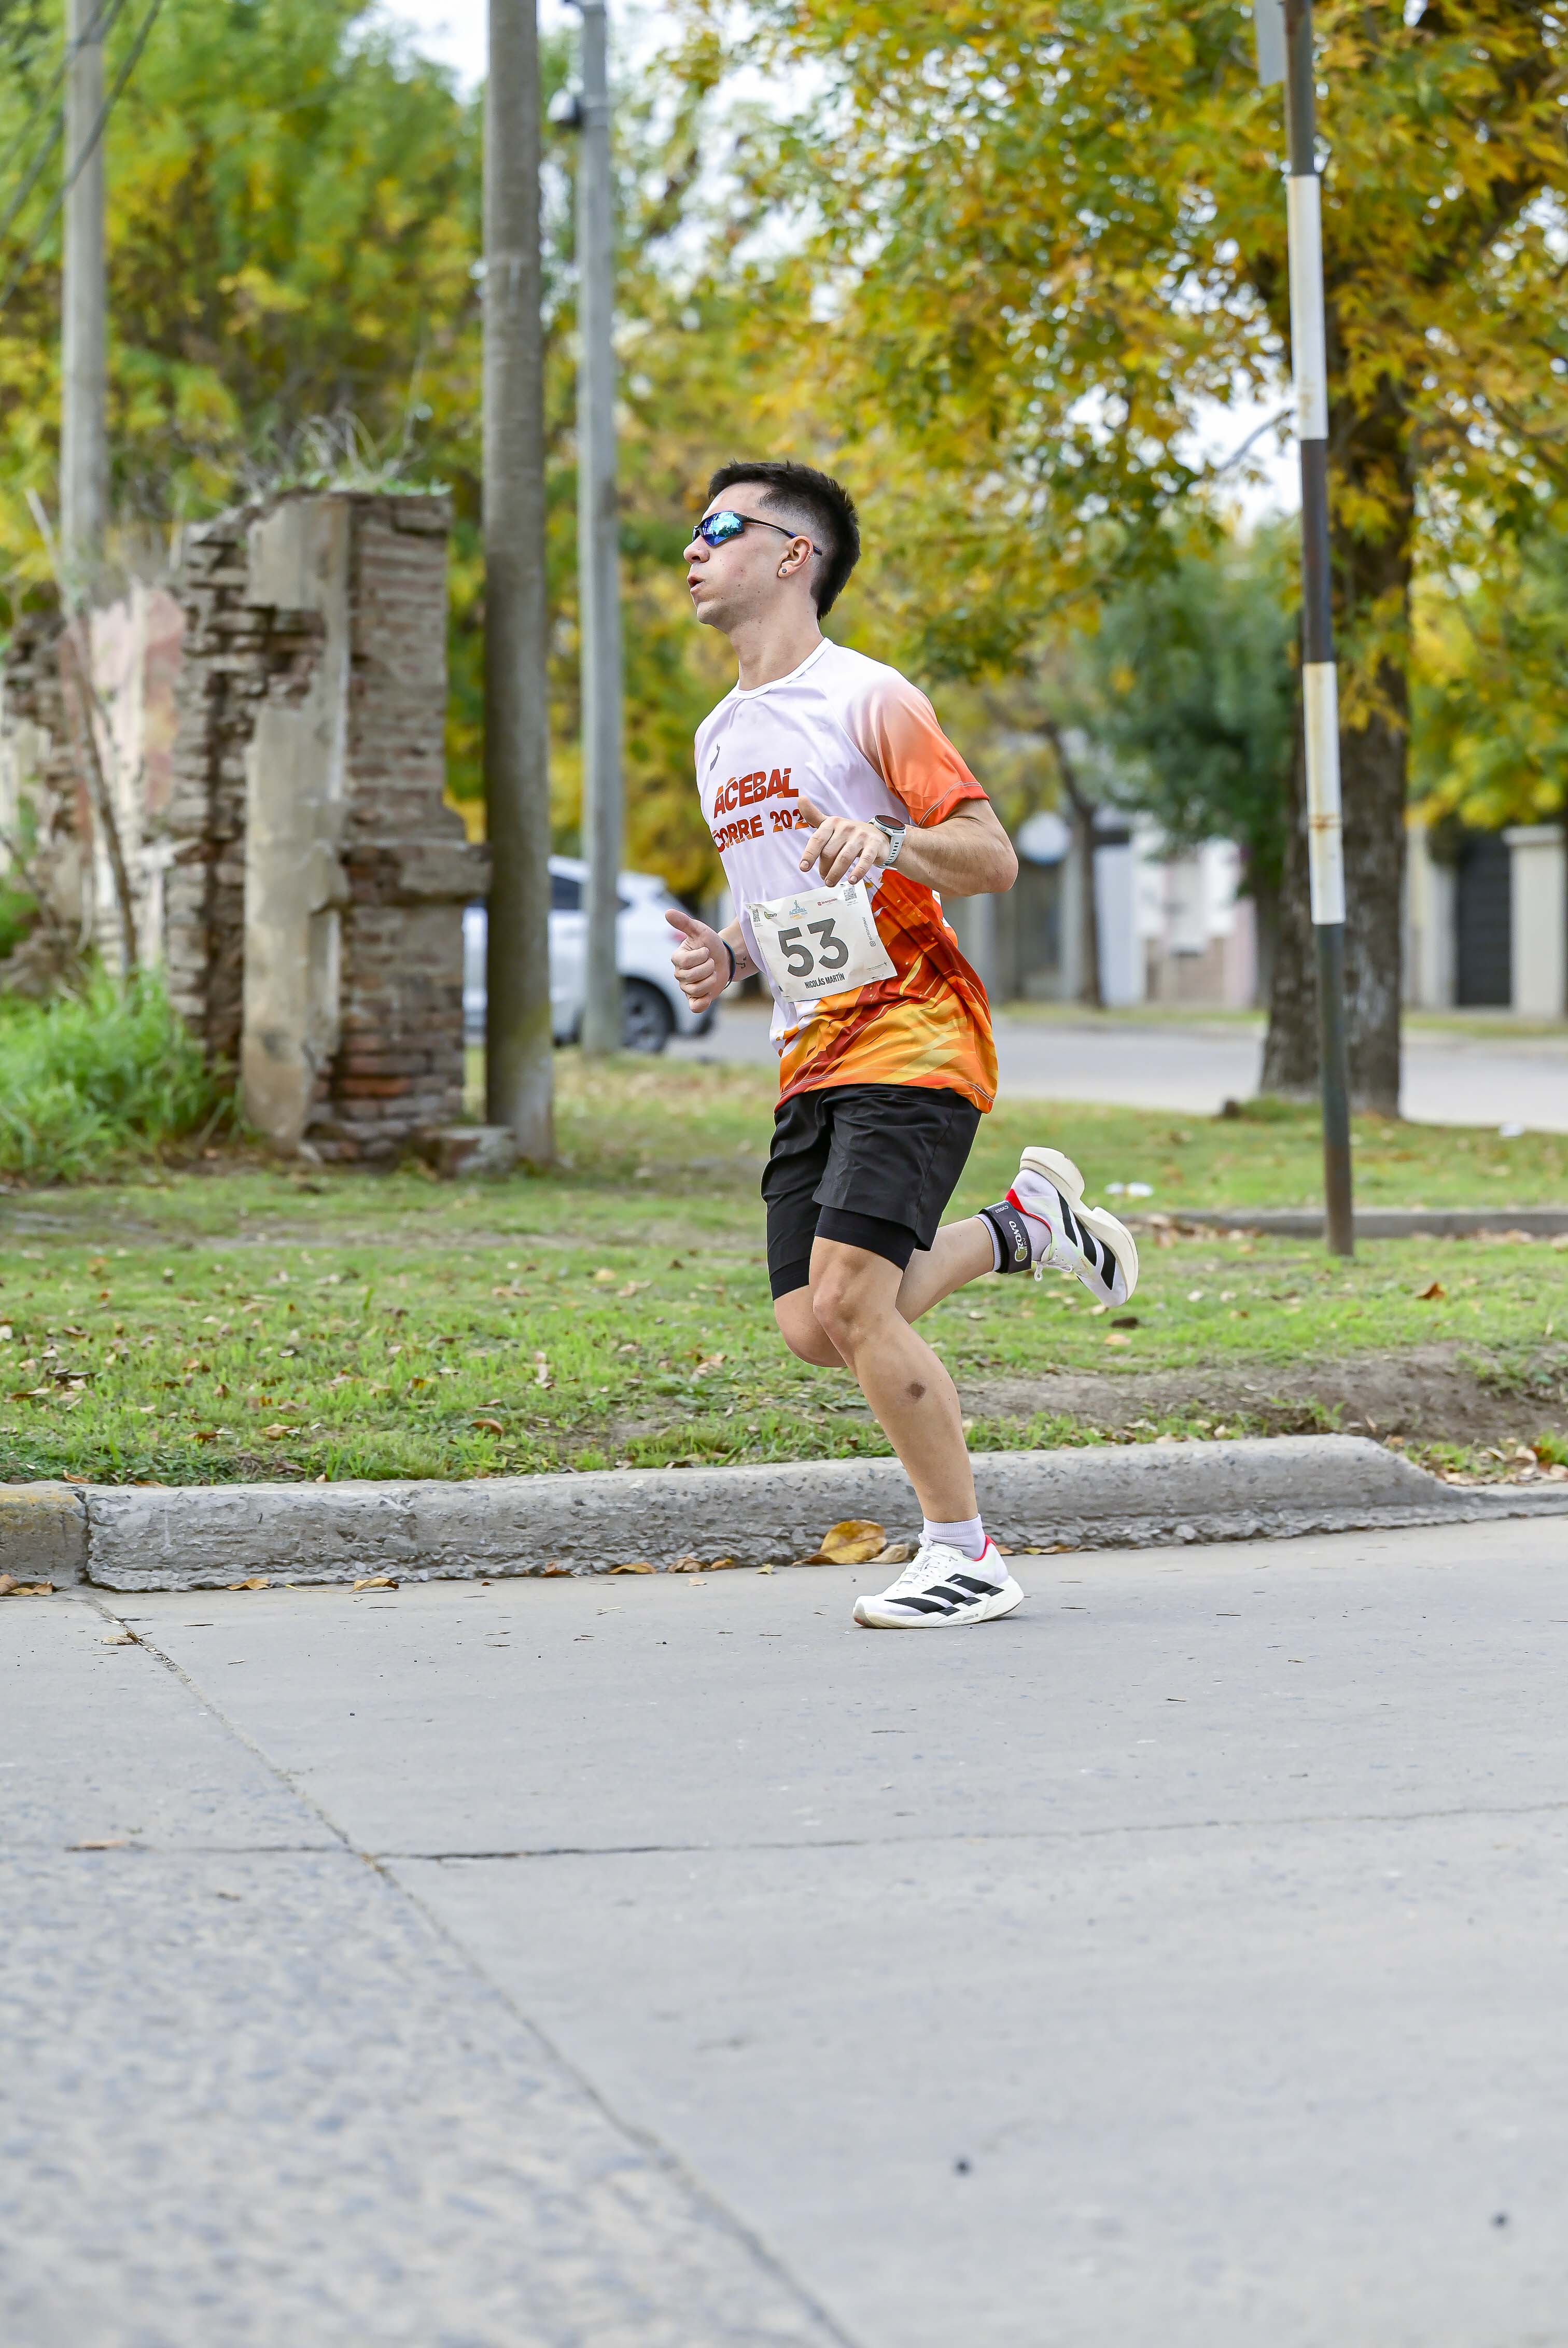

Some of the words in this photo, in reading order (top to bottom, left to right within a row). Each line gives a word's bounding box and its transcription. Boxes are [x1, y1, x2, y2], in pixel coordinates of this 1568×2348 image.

[714, 768, 799, 819] ACEBAL
[712, 814, 764, 852] CORRE
[769, 808, 818, 833] 202
[778, 918, 848, 977] 53
[804, 976, 825, 989] NICOLÁS
[825, 972, 845, 984] MARTÍN
